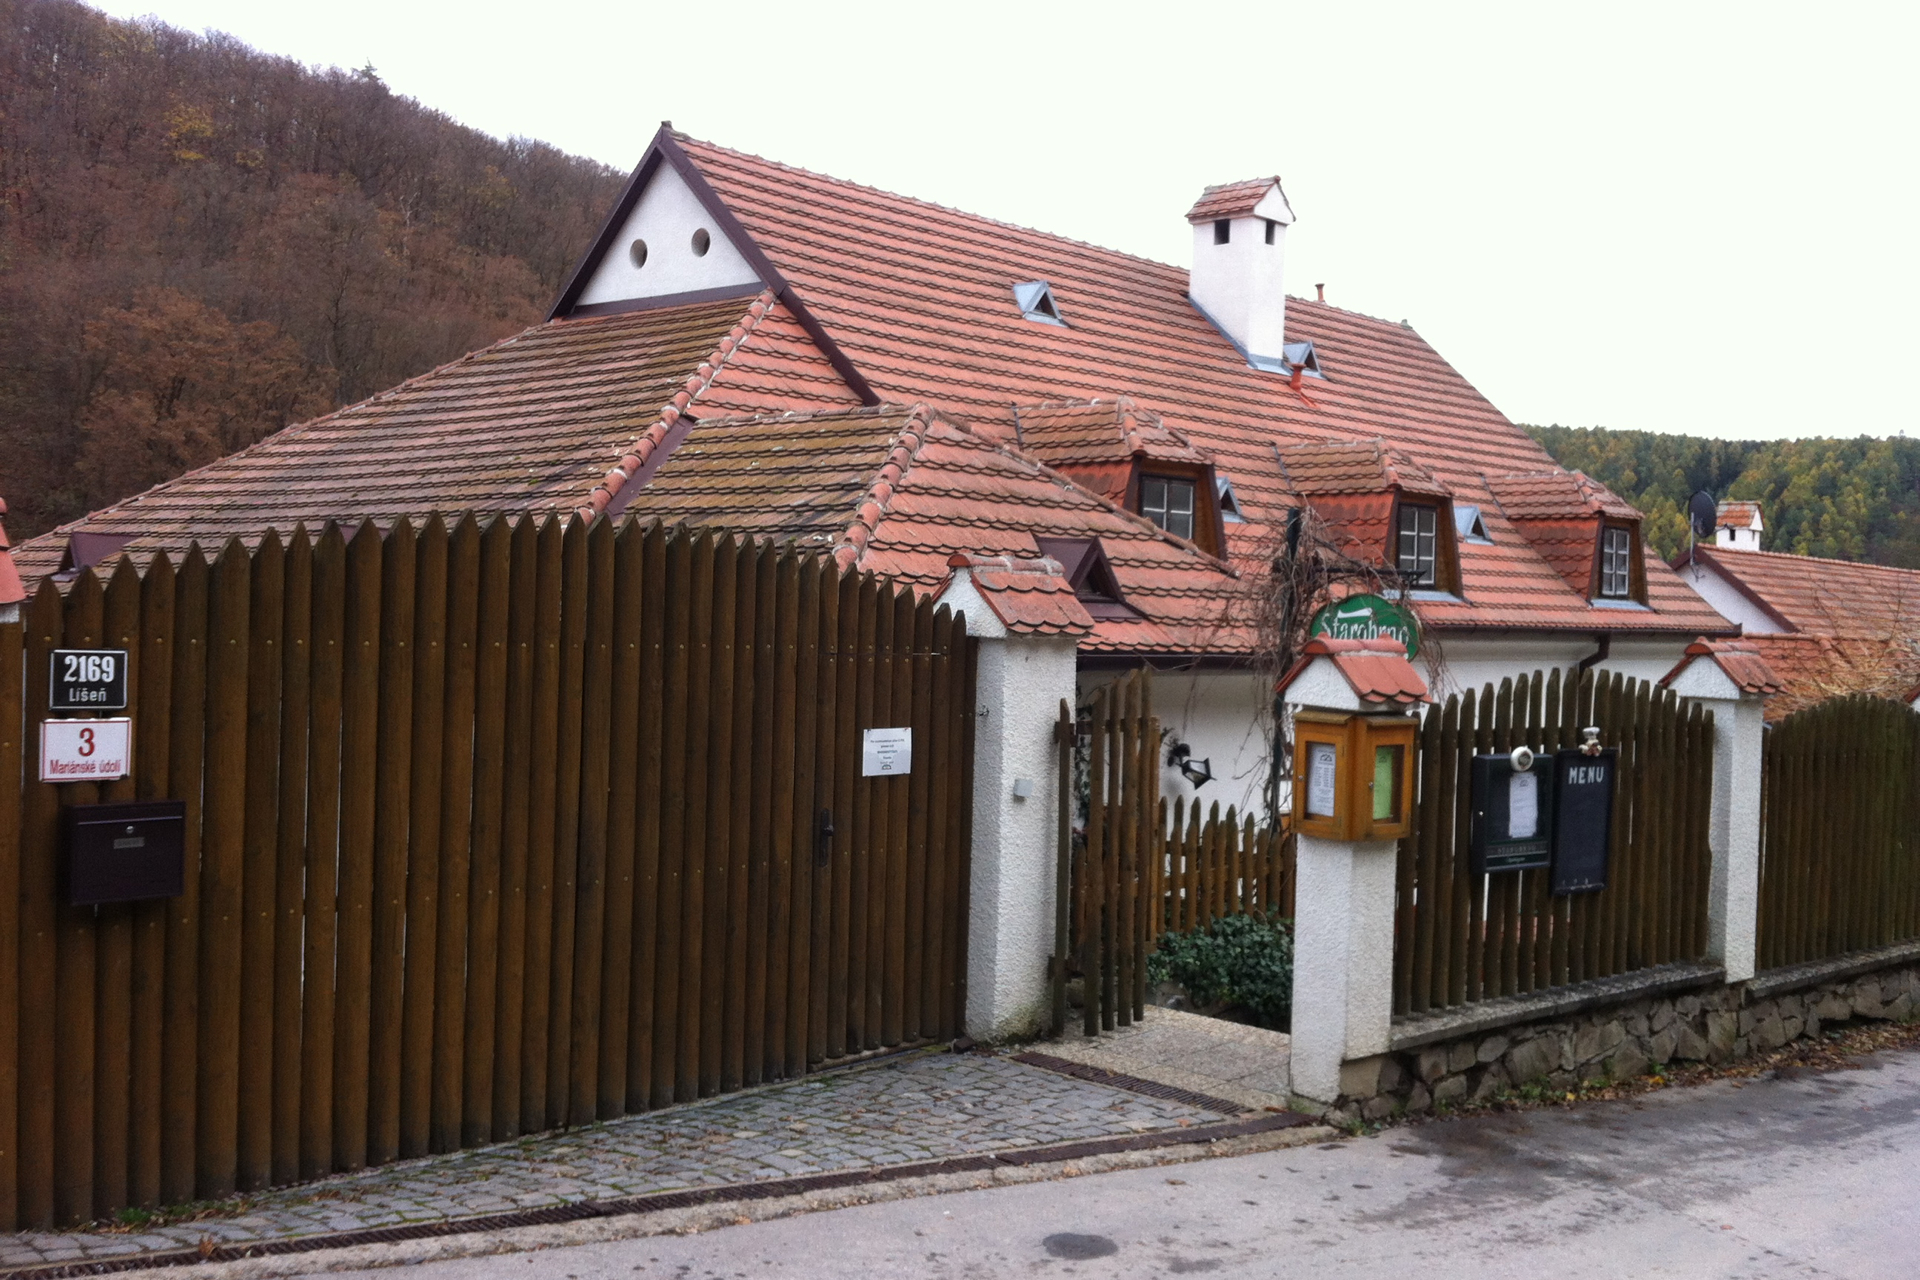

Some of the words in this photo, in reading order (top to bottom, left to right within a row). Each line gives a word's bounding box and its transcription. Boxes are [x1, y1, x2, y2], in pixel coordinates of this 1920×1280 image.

[63, 655, 115, 683] 2169
[69, 687, 107, 702] Líšeň
[78, 727, 95, 757] 3
[50, 759, 96, 774] Mariánské
[99, 759, 121, 774] údolí
[1568, 766, 1605, 785] MENU
